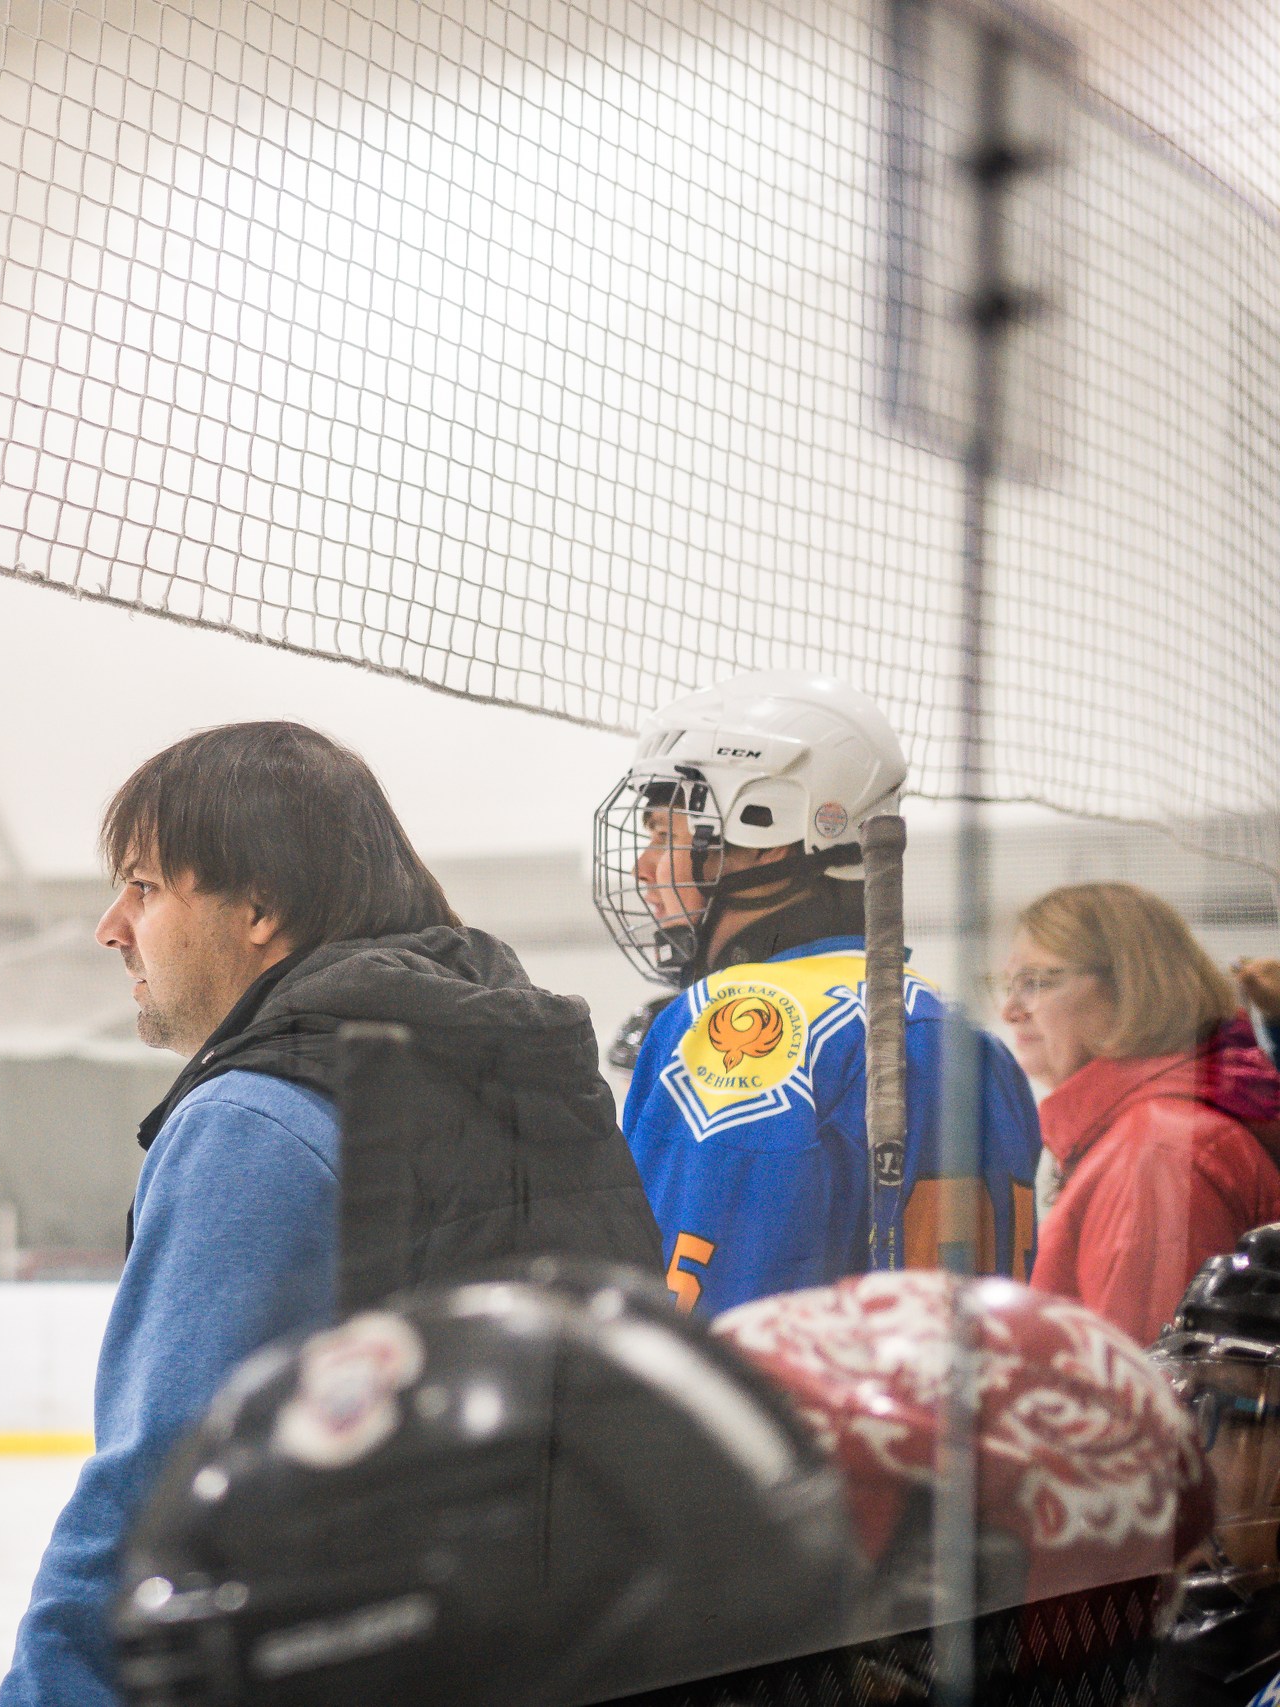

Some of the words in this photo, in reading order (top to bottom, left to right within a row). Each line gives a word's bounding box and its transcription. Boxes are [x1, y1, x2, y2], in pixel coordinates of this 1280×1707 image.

[716, 747, 762, 759] CCM
[779, 997, 803, 1059] ОБЛАСТЬ
[696, 1065, 763, 1089] ФЕНИКС
